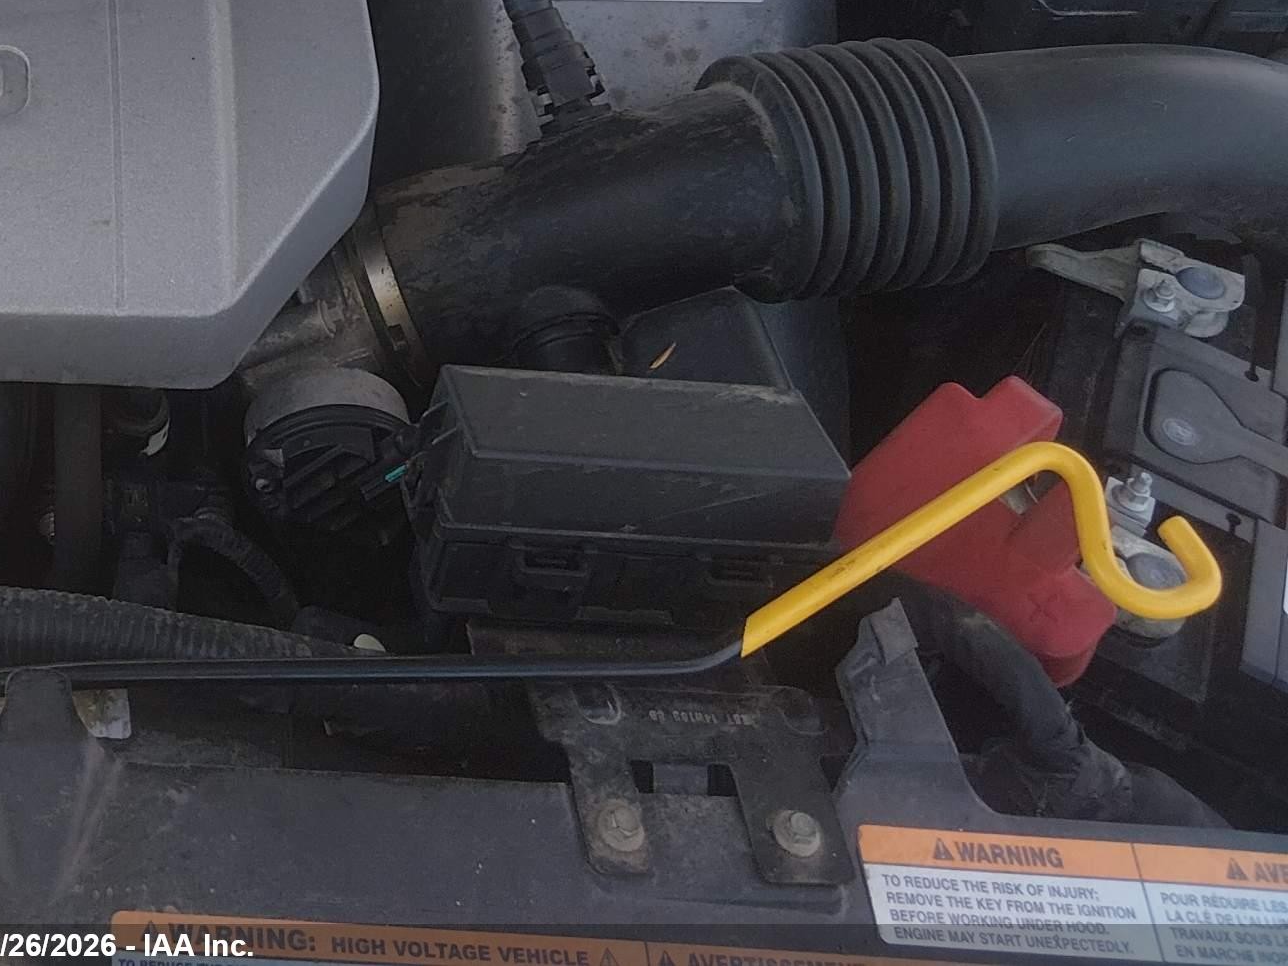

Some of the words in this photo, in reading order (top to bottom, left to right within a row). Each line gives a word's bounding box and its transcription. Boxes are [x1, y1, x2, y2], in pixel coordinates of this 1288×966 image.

[954, 841, 1065, 869] WARNING
[882, 874, 902, 887] TO
[903, 876, 960, 892] REDUCE
[961, 880, 990, 893] THE
[991, 882, 1025, 895] RISK
[1026, 883, 1044, 897] OF
[886, 892, 944, 908] REMOVE
[946, 895, 974, 909] THE
[976, 897, 1003, 912] KEY
[1006, 900, 1046, 914] FROM
[1047, 902, 1075, 916] THE
[1077, 904, 1137, 920] IGNITION
[1160, 892, 1200, 907] POUR
[889, 909, 946, 924] BEFORE
[948, 913, 1013, 930] WORKING
[1016, 917, 1064, 933] UNDER
[1065, 921, 1111, 935] HOOD.
[1165, 910, 1185, 923] LA
[1186, 910, 1213, 925] CLÉ
[1215, 913, 1234, 926] DE
[894, 926, 944, 942] ENGINE
[947, 930, 977, 944] MAY
[979, 932, 1022, 947] START
[1170, 926, 1233, 943] TRAVAUX
[1234, 931, 1273, 946] SOUS
[331, 936, 386, 955] HIGH
[393, 940, 492, 962] VOLTAGE
[497, 946, 591, 966] VEHICLE
[1175, 945, 1196, 958] EN
